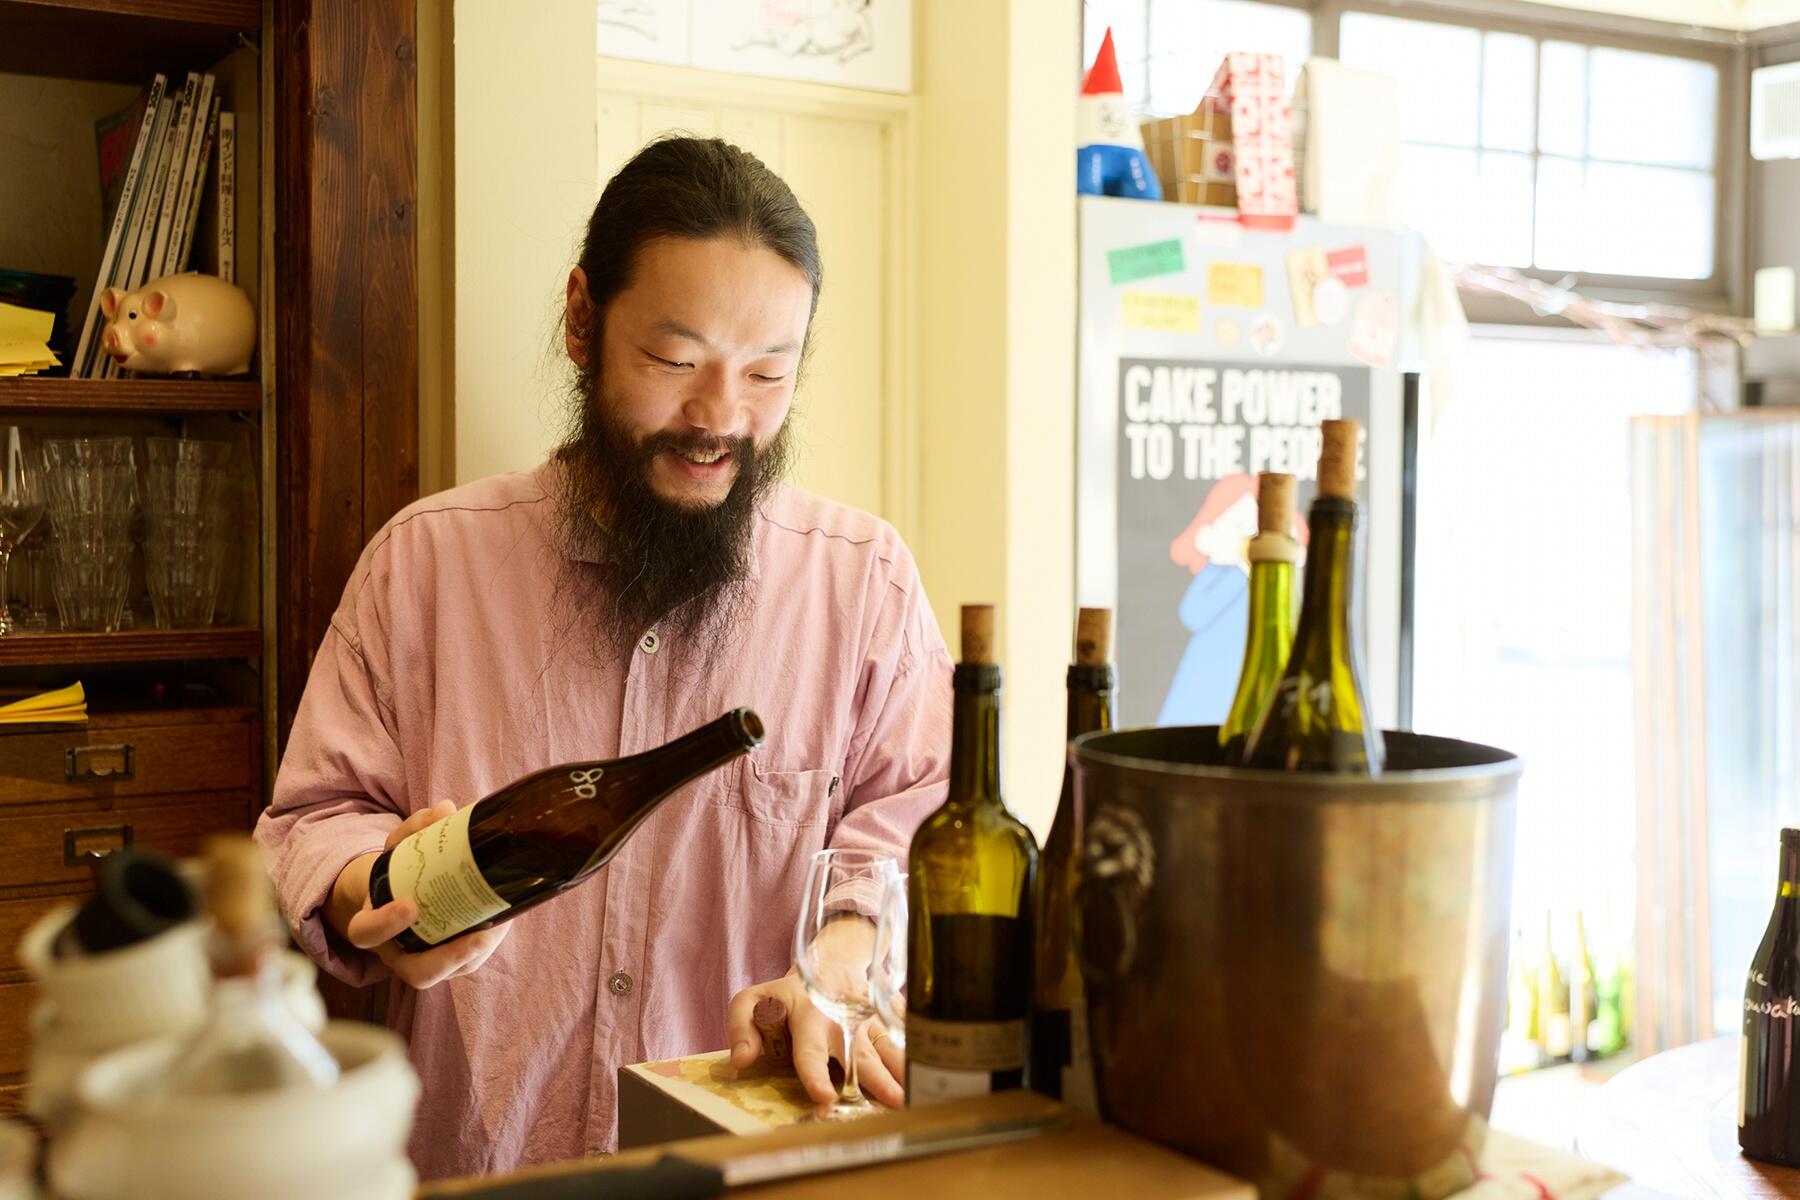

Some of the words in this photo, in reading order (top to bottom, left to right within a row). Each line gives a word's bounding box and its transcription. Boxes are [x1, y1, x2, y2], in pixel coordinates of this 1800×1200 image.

[1125, 366, 1217, 423] CAKE
[1221, 368, 1342, 426] POWER
[1125, 423, 1173, 480] TO
[1179, 424, 1245, 480] THE
[1250, 425, 1367, 481] PEOPE
